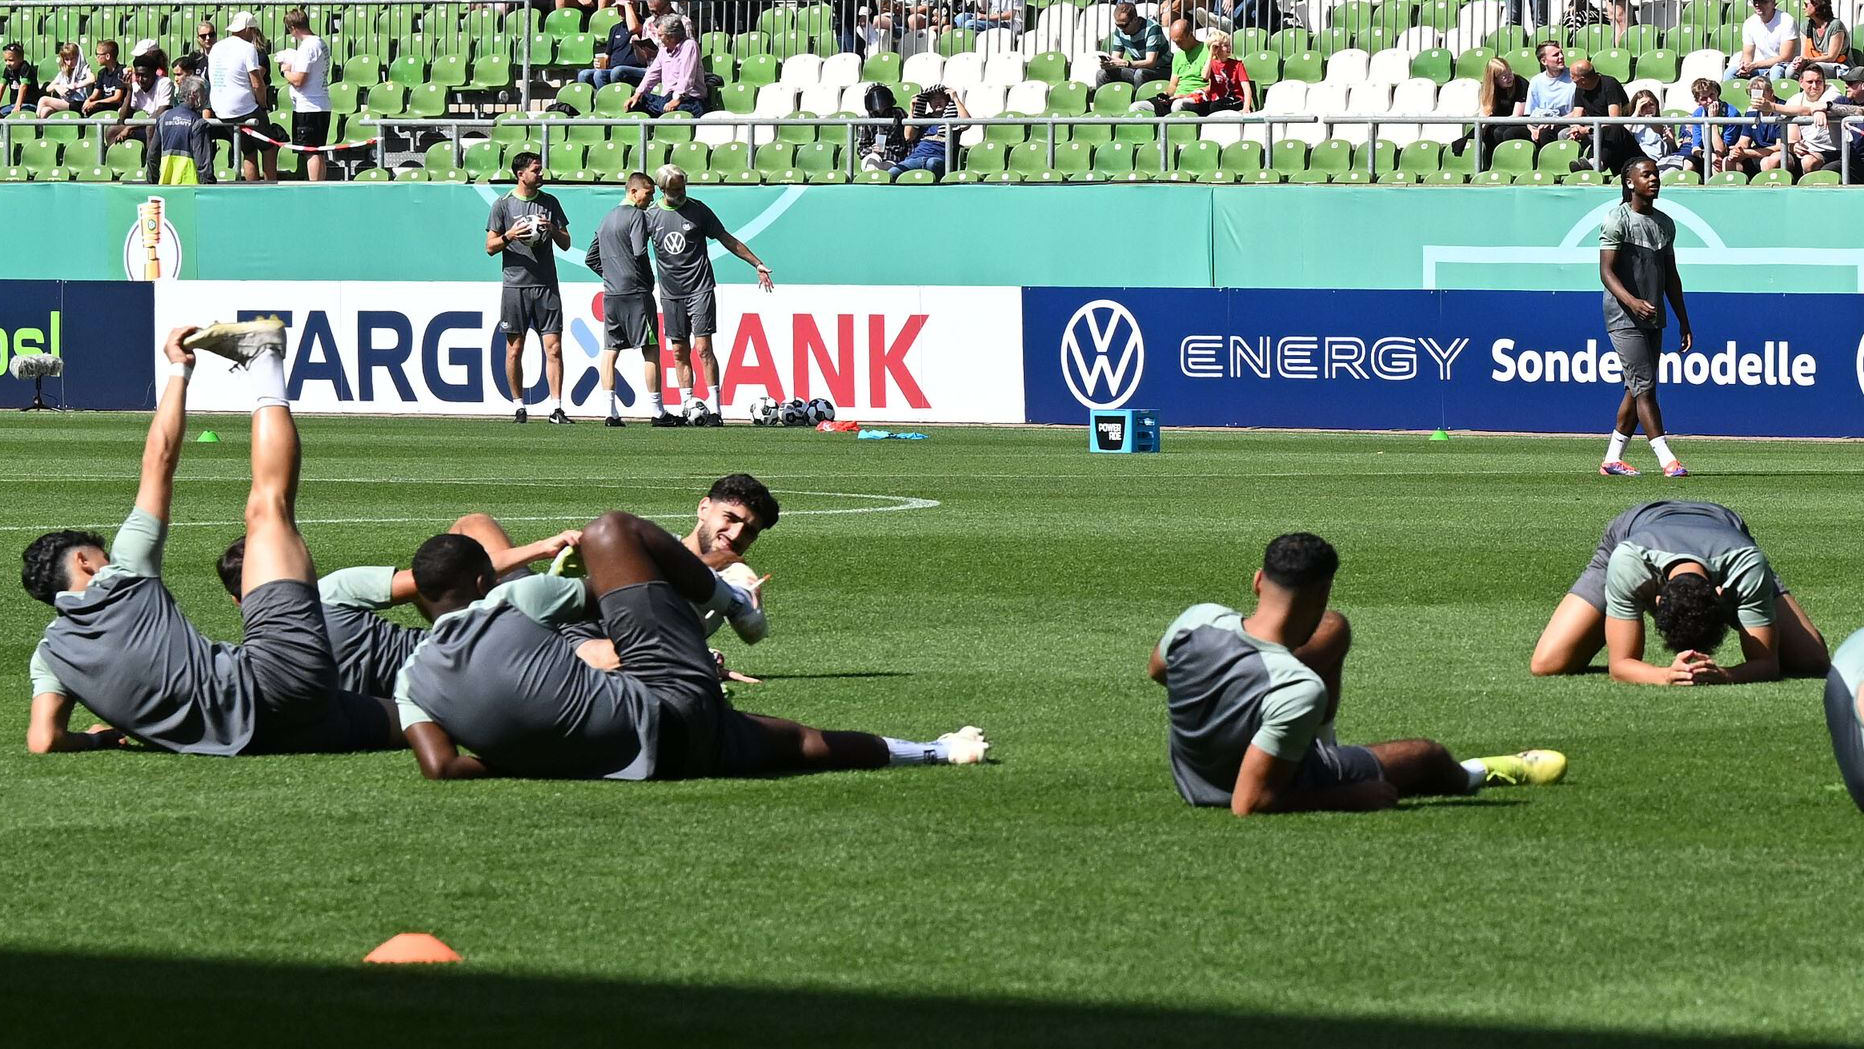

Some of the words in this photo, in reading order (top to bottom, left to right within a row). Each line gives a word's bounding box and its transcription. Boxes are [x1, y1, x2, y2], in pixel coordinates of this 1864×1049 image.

[1180, 334, 1470, 381] ENERGY
[1491, 338, 1817, 388] Sondemodelle
[1098, 423, 1122, 433] POWER
